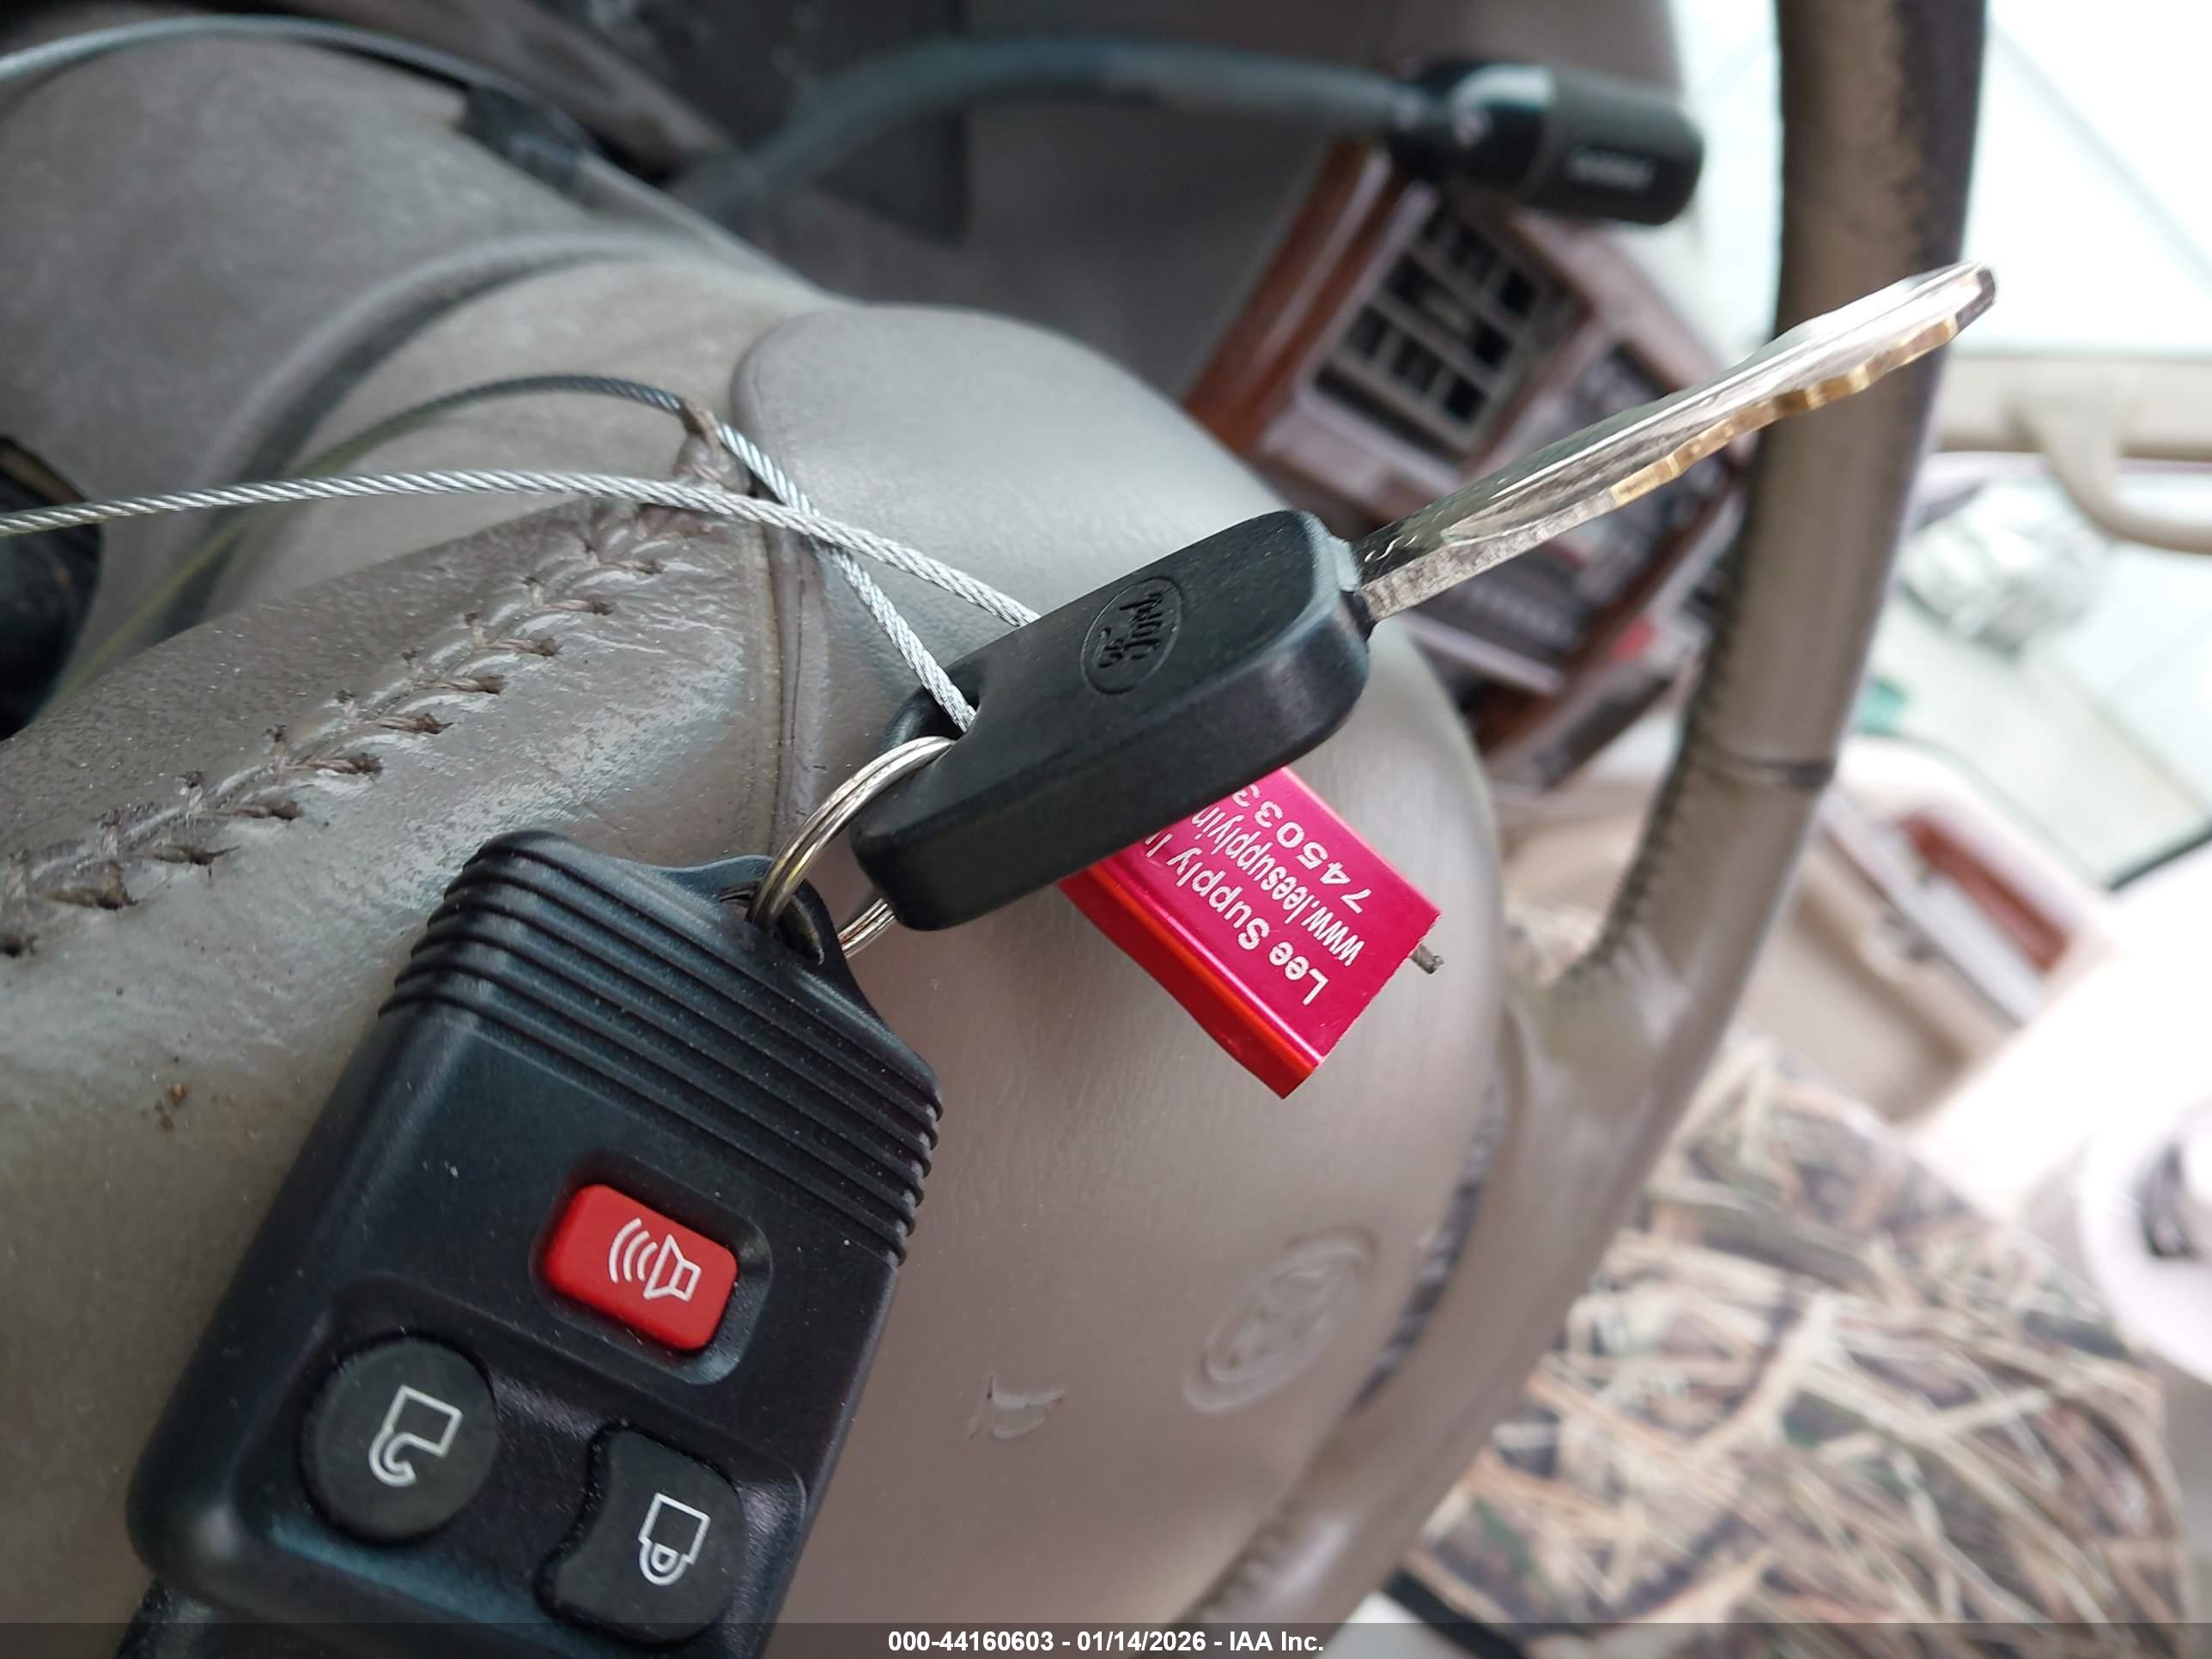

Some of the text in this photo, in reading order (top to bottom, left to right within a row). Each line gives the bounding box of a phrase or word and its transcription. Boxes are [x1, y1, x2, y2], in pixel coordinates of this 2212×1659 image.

[1082, 583, 1163, 669] Ford
[1232, 784, 1372, 913] 745033
[1167, 848, 1270, 951] Supply
[1268, 941, 1330, 1006] Lee
